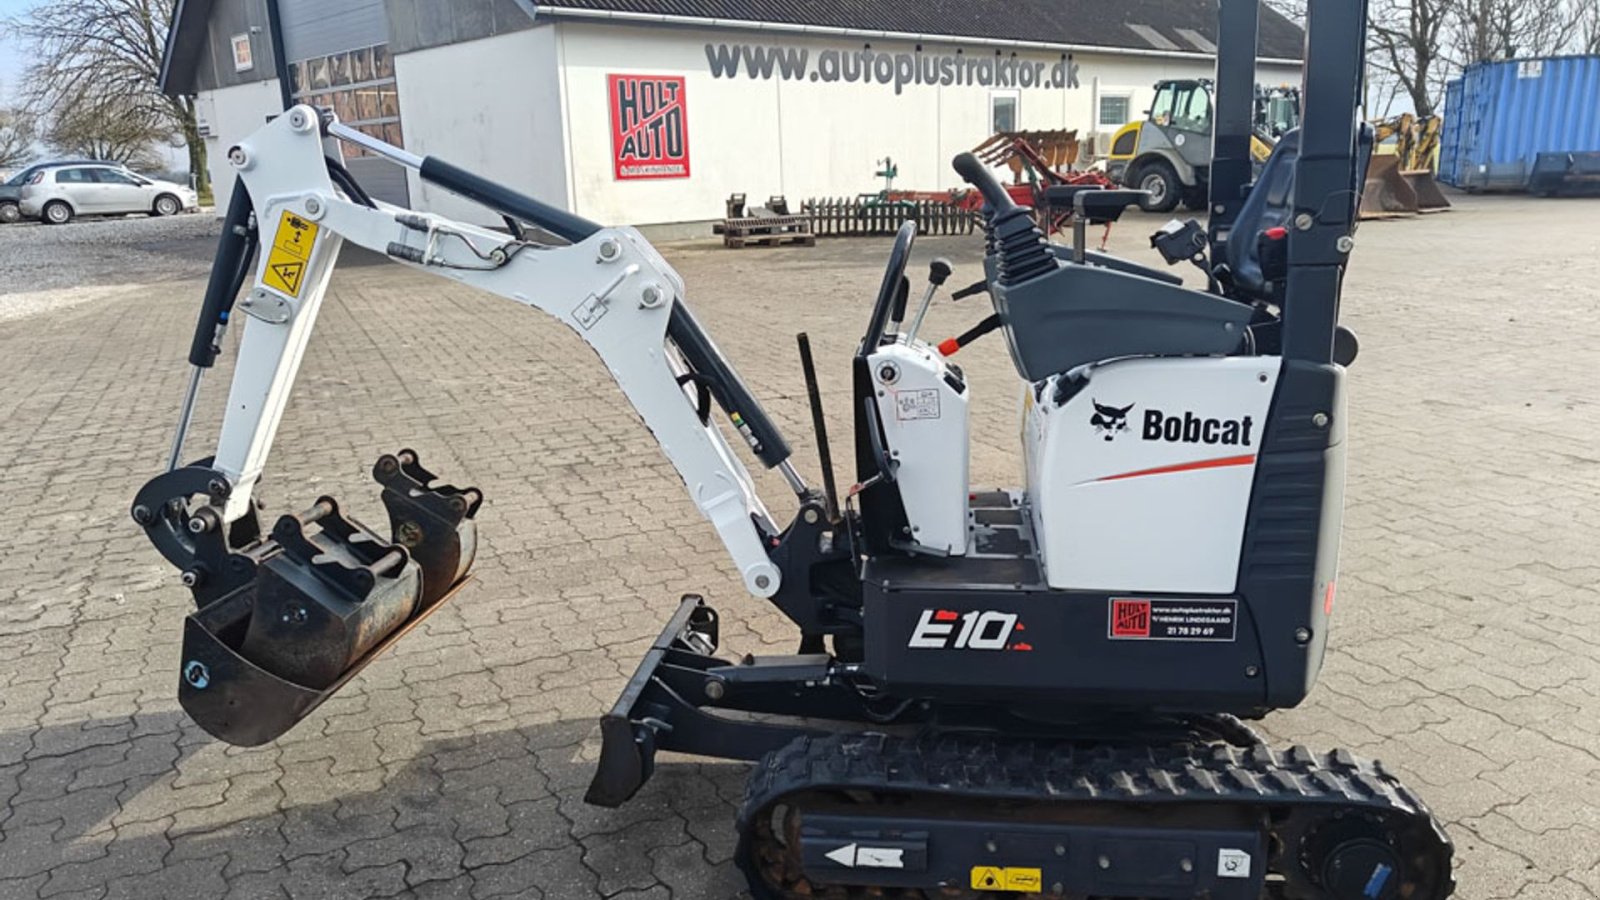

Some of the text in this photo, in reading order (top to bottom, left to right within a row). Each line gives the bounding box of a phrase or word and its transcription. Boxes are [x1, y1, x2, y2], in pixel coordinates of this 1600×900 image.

[704, 43, 1081, 95] www.autoplustraktor.dk
[617, 79, 680, 135] HOLT
[620, 104, 684, 160] AUTO
[1142, 409, 1253, 446] Bobcat
[1116, 611, 1147, 630] AUTO
[1117, 602, 1147, 620] HOLT
[1167, 626, 1177, 636] 21
[1190, 627, 1201, 636] 29
[1202, 627, 1215, 636] 69
